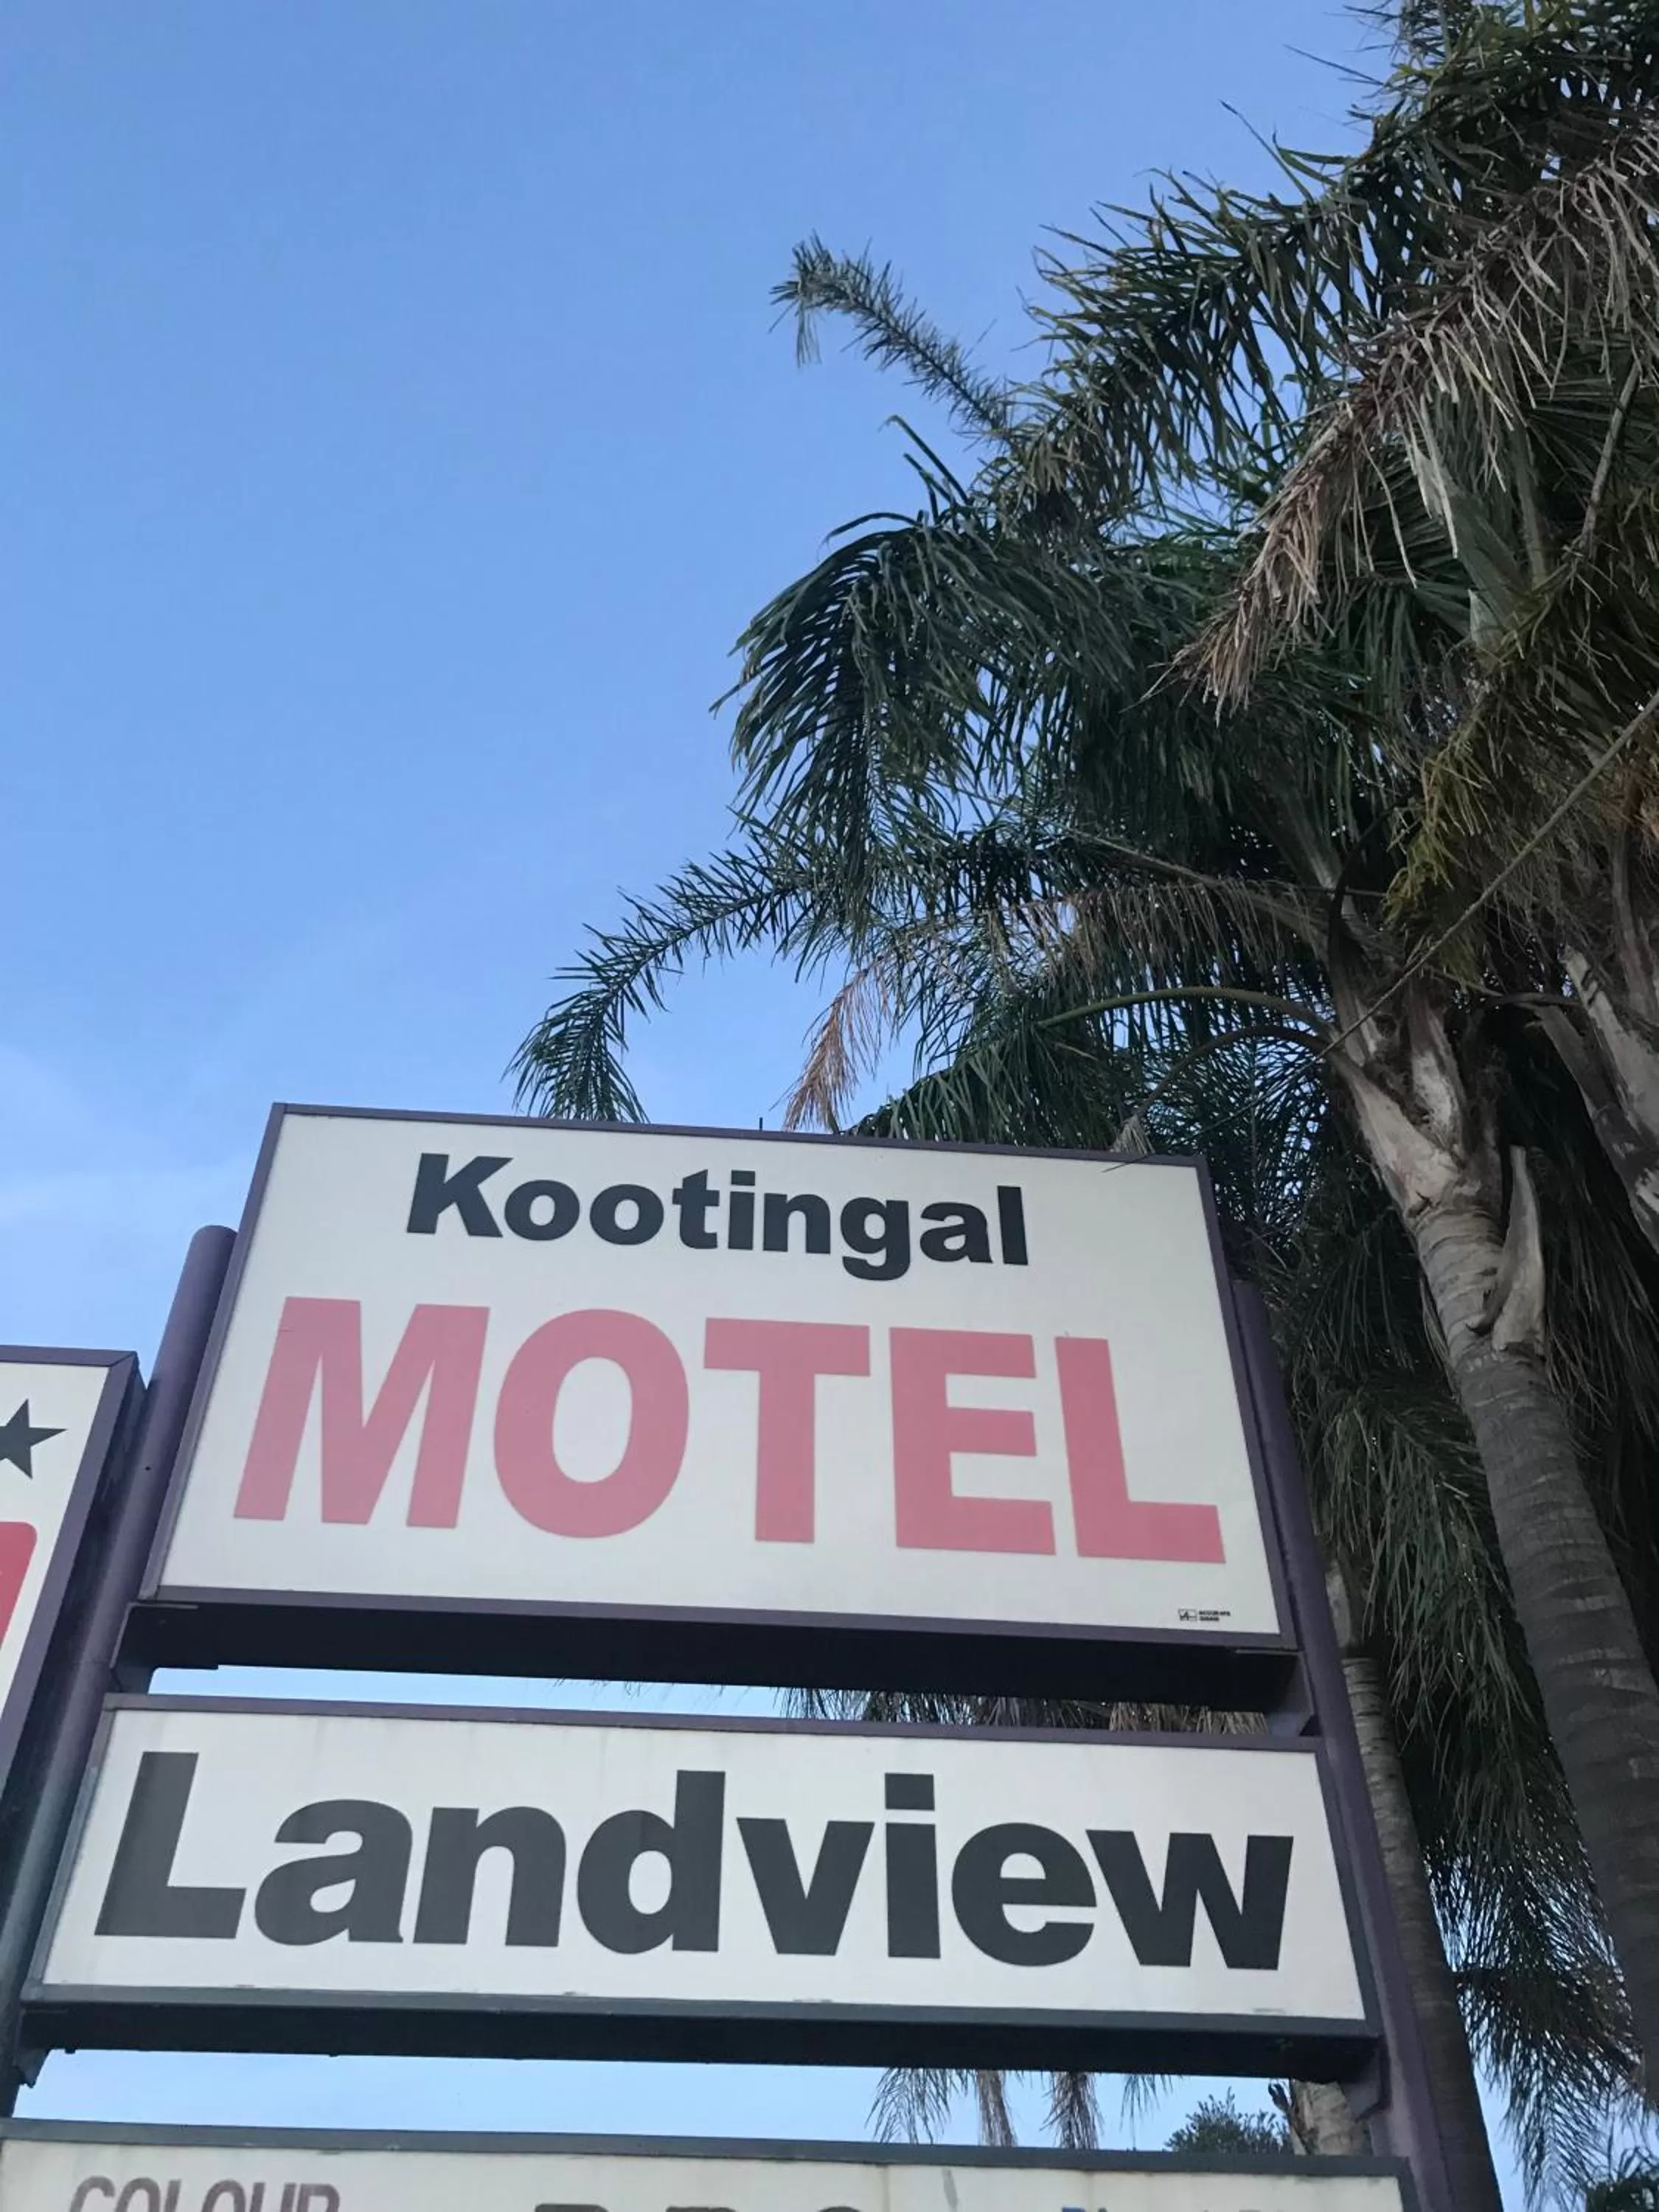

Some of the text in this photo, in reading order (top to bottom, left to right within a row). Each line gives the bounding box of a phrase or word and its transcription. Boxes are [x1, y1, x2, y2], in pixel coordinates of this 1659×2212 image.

[407, 1152, 1029, 1281] Kootingal
[234, 1296, 1226, 1564] MOTEL
[94, 1750, 1294, 1971] Landview
